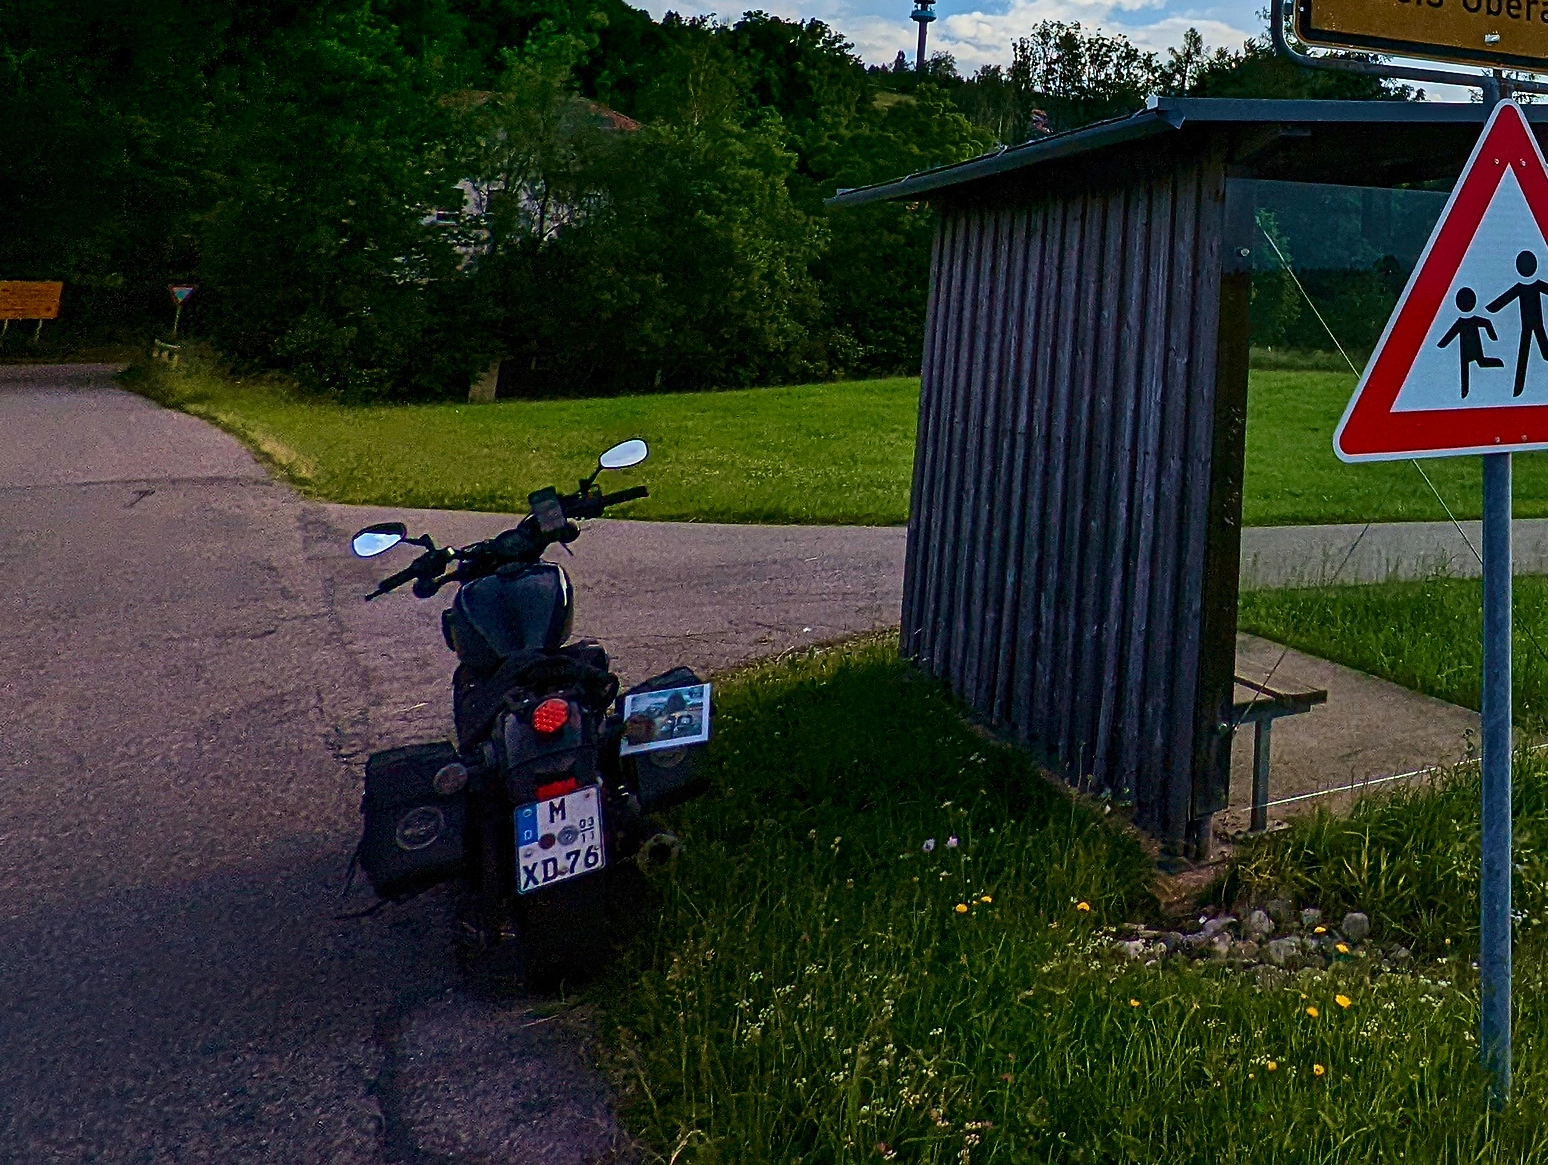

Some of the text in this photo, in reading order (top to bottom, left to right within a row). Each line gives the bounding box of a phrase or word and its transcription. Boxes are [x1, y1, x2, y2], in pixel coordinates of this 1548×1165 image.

[548, 797, 567, 824] M
[524, 830, 533, 841] D
[523, 845, 600, 890] XD 76
